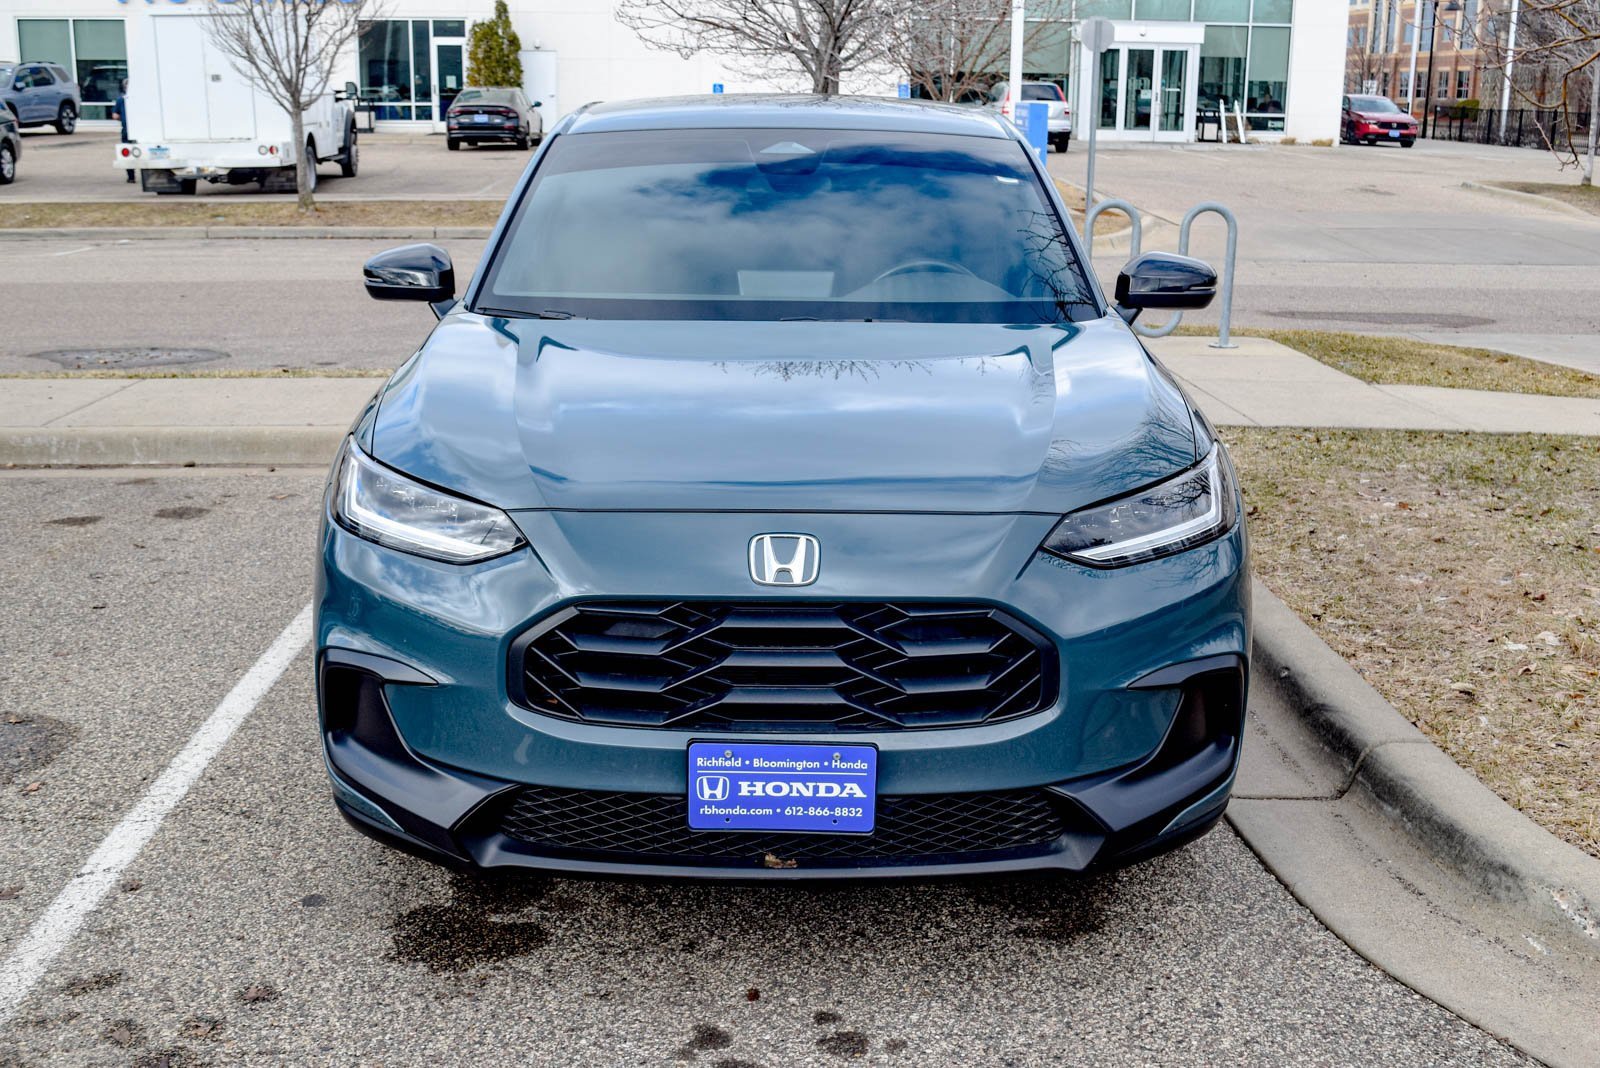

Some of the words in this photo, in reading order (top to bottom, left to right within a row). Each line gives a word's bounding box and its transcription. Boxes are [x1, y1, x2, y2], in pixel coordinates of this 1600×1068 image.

[696, 757, 742, 768] Richfield
[753, 758, 820, 770] Bloomington
[831, 759, 868, 769] Honda
[737, 781, 868, 798] HONDA
[699, 805, 773, 815] rbhonda.com
[784, 806, 863, 817] 612-866-8832
